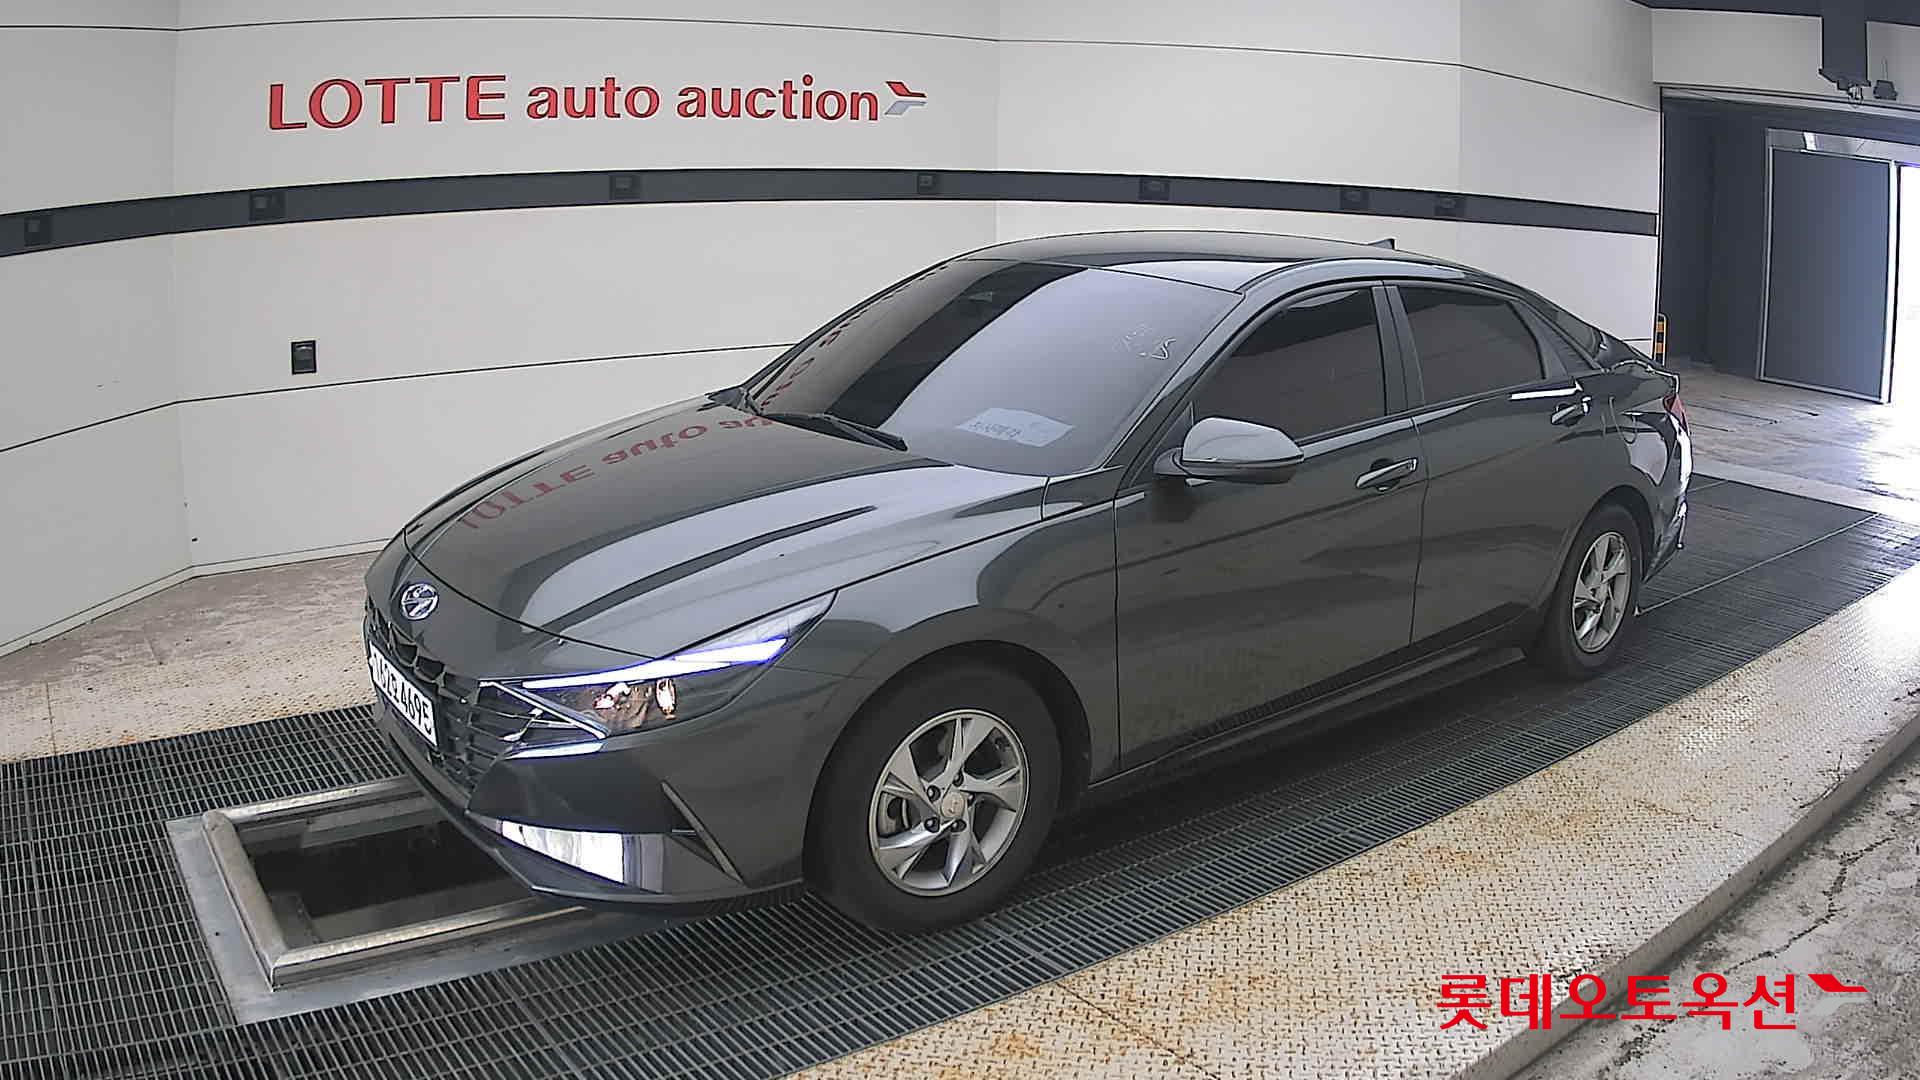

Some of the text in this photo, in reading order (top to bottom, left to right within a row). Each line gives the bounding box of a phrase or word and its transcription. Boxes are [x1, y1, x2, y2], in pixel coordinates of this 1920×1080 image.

[267, 74, 880, 130] LOTTE auto auction
